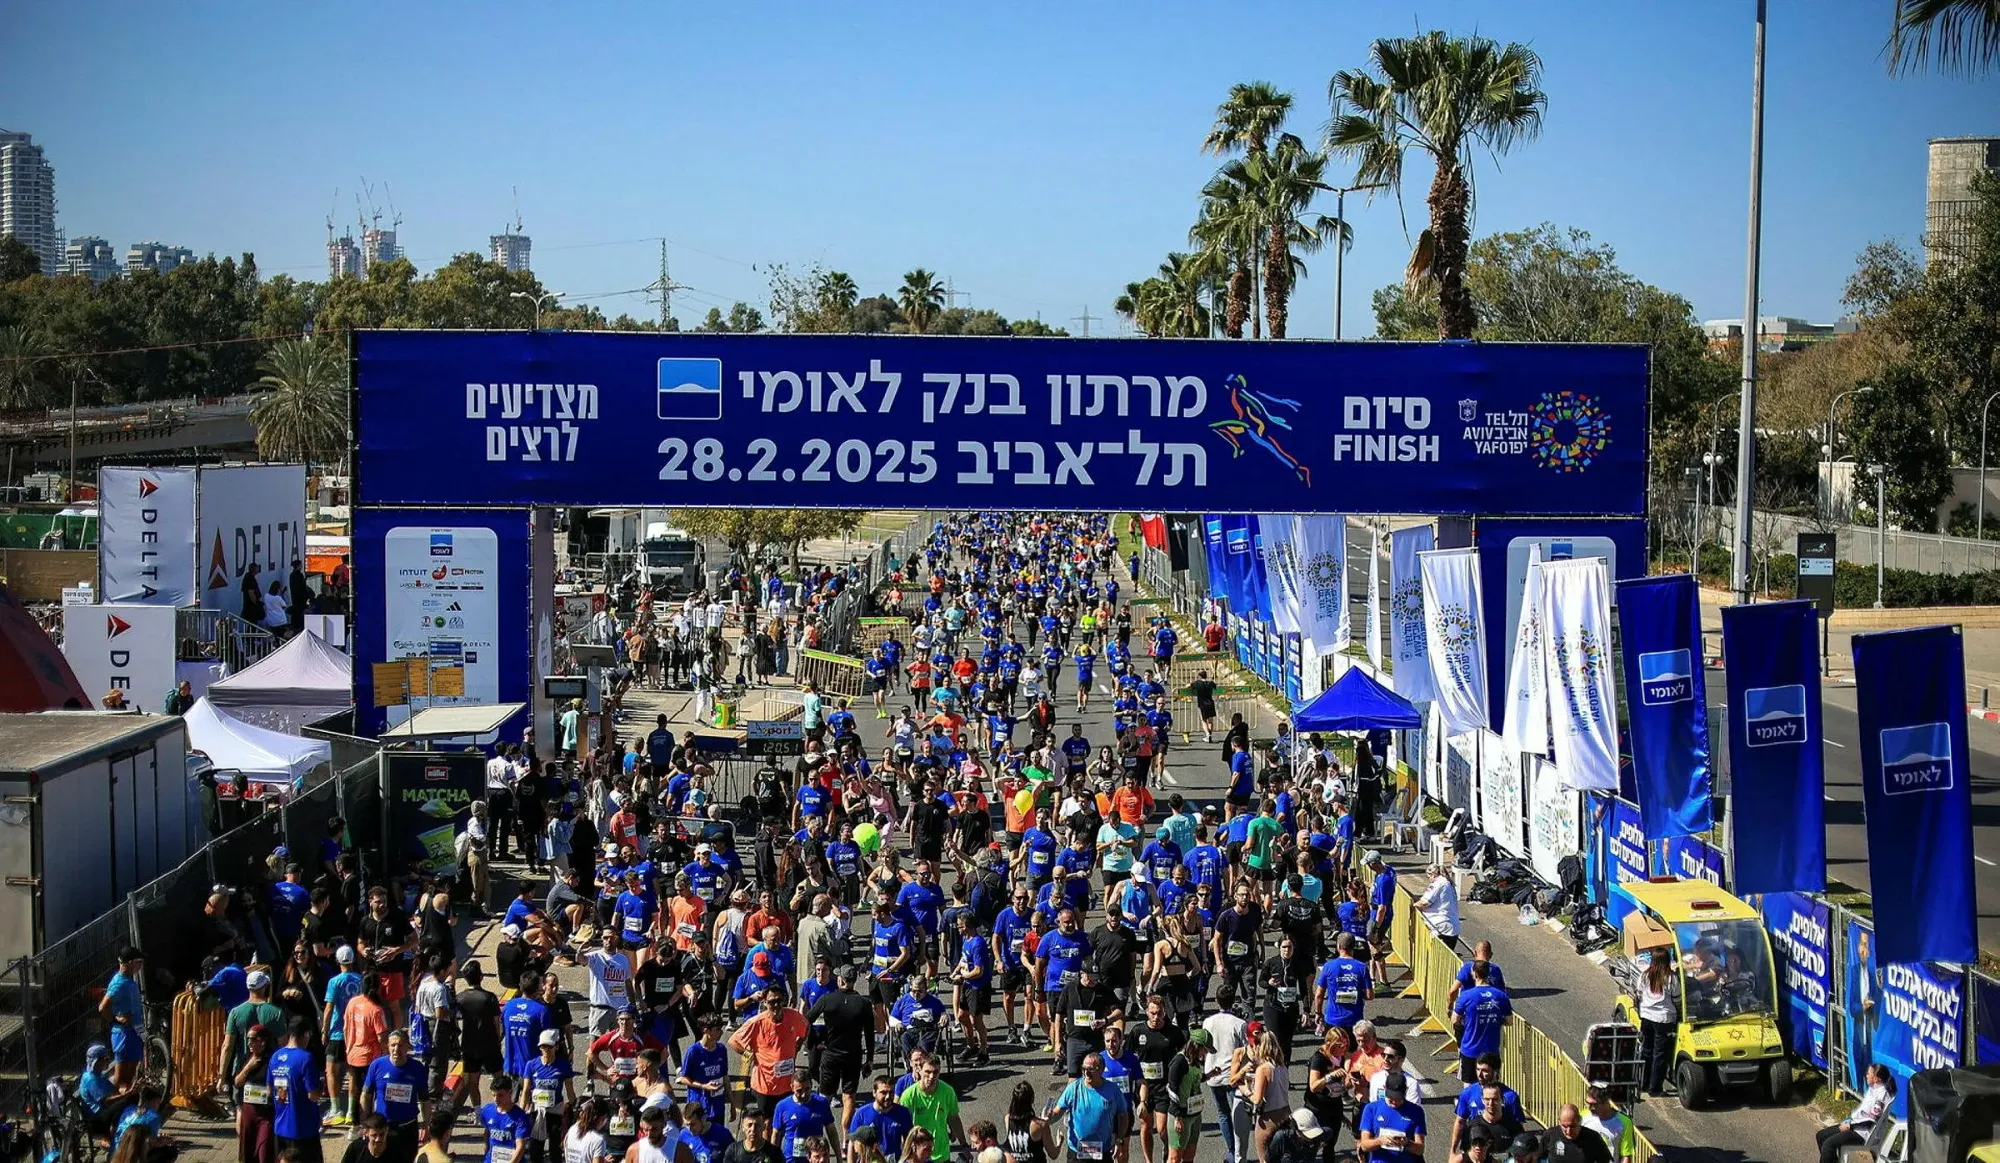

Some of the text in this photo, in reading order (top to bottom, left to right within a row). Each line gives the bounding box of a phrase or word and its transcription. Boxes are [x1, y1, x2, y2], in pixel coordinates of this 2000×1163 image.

[466, 383, 598, 419] מצדיעים
[738, 359, 1207, 425] מרתון בנק לאומי
[1344, 396, 1431, 430] סיום
[1484, 409, 1528, 426] TEL תל
[487, 421, 579, 461] לרצים
[1463, 426, 1528, 440] AVIV אביב
[658, 437, 937, 483] 28.2.2025
[1334, 435, 1439, 462] FINISH
[1475, 441, 1528, 454] YAFO יפו
[141, 508, 157, 600] DELTA
[234, 520, 301, 578] DELTA
[1650, 682, 1685, 698] לאומי
[1589, 700, 1601, 723] YAFO
[1756, 722, 1797, 739] לאומי
[1894, 765, 1942, 785] לאומי
[402, 788, 471, 802] MATCHA
[1790, 909, 1826, 950] אלופים,
